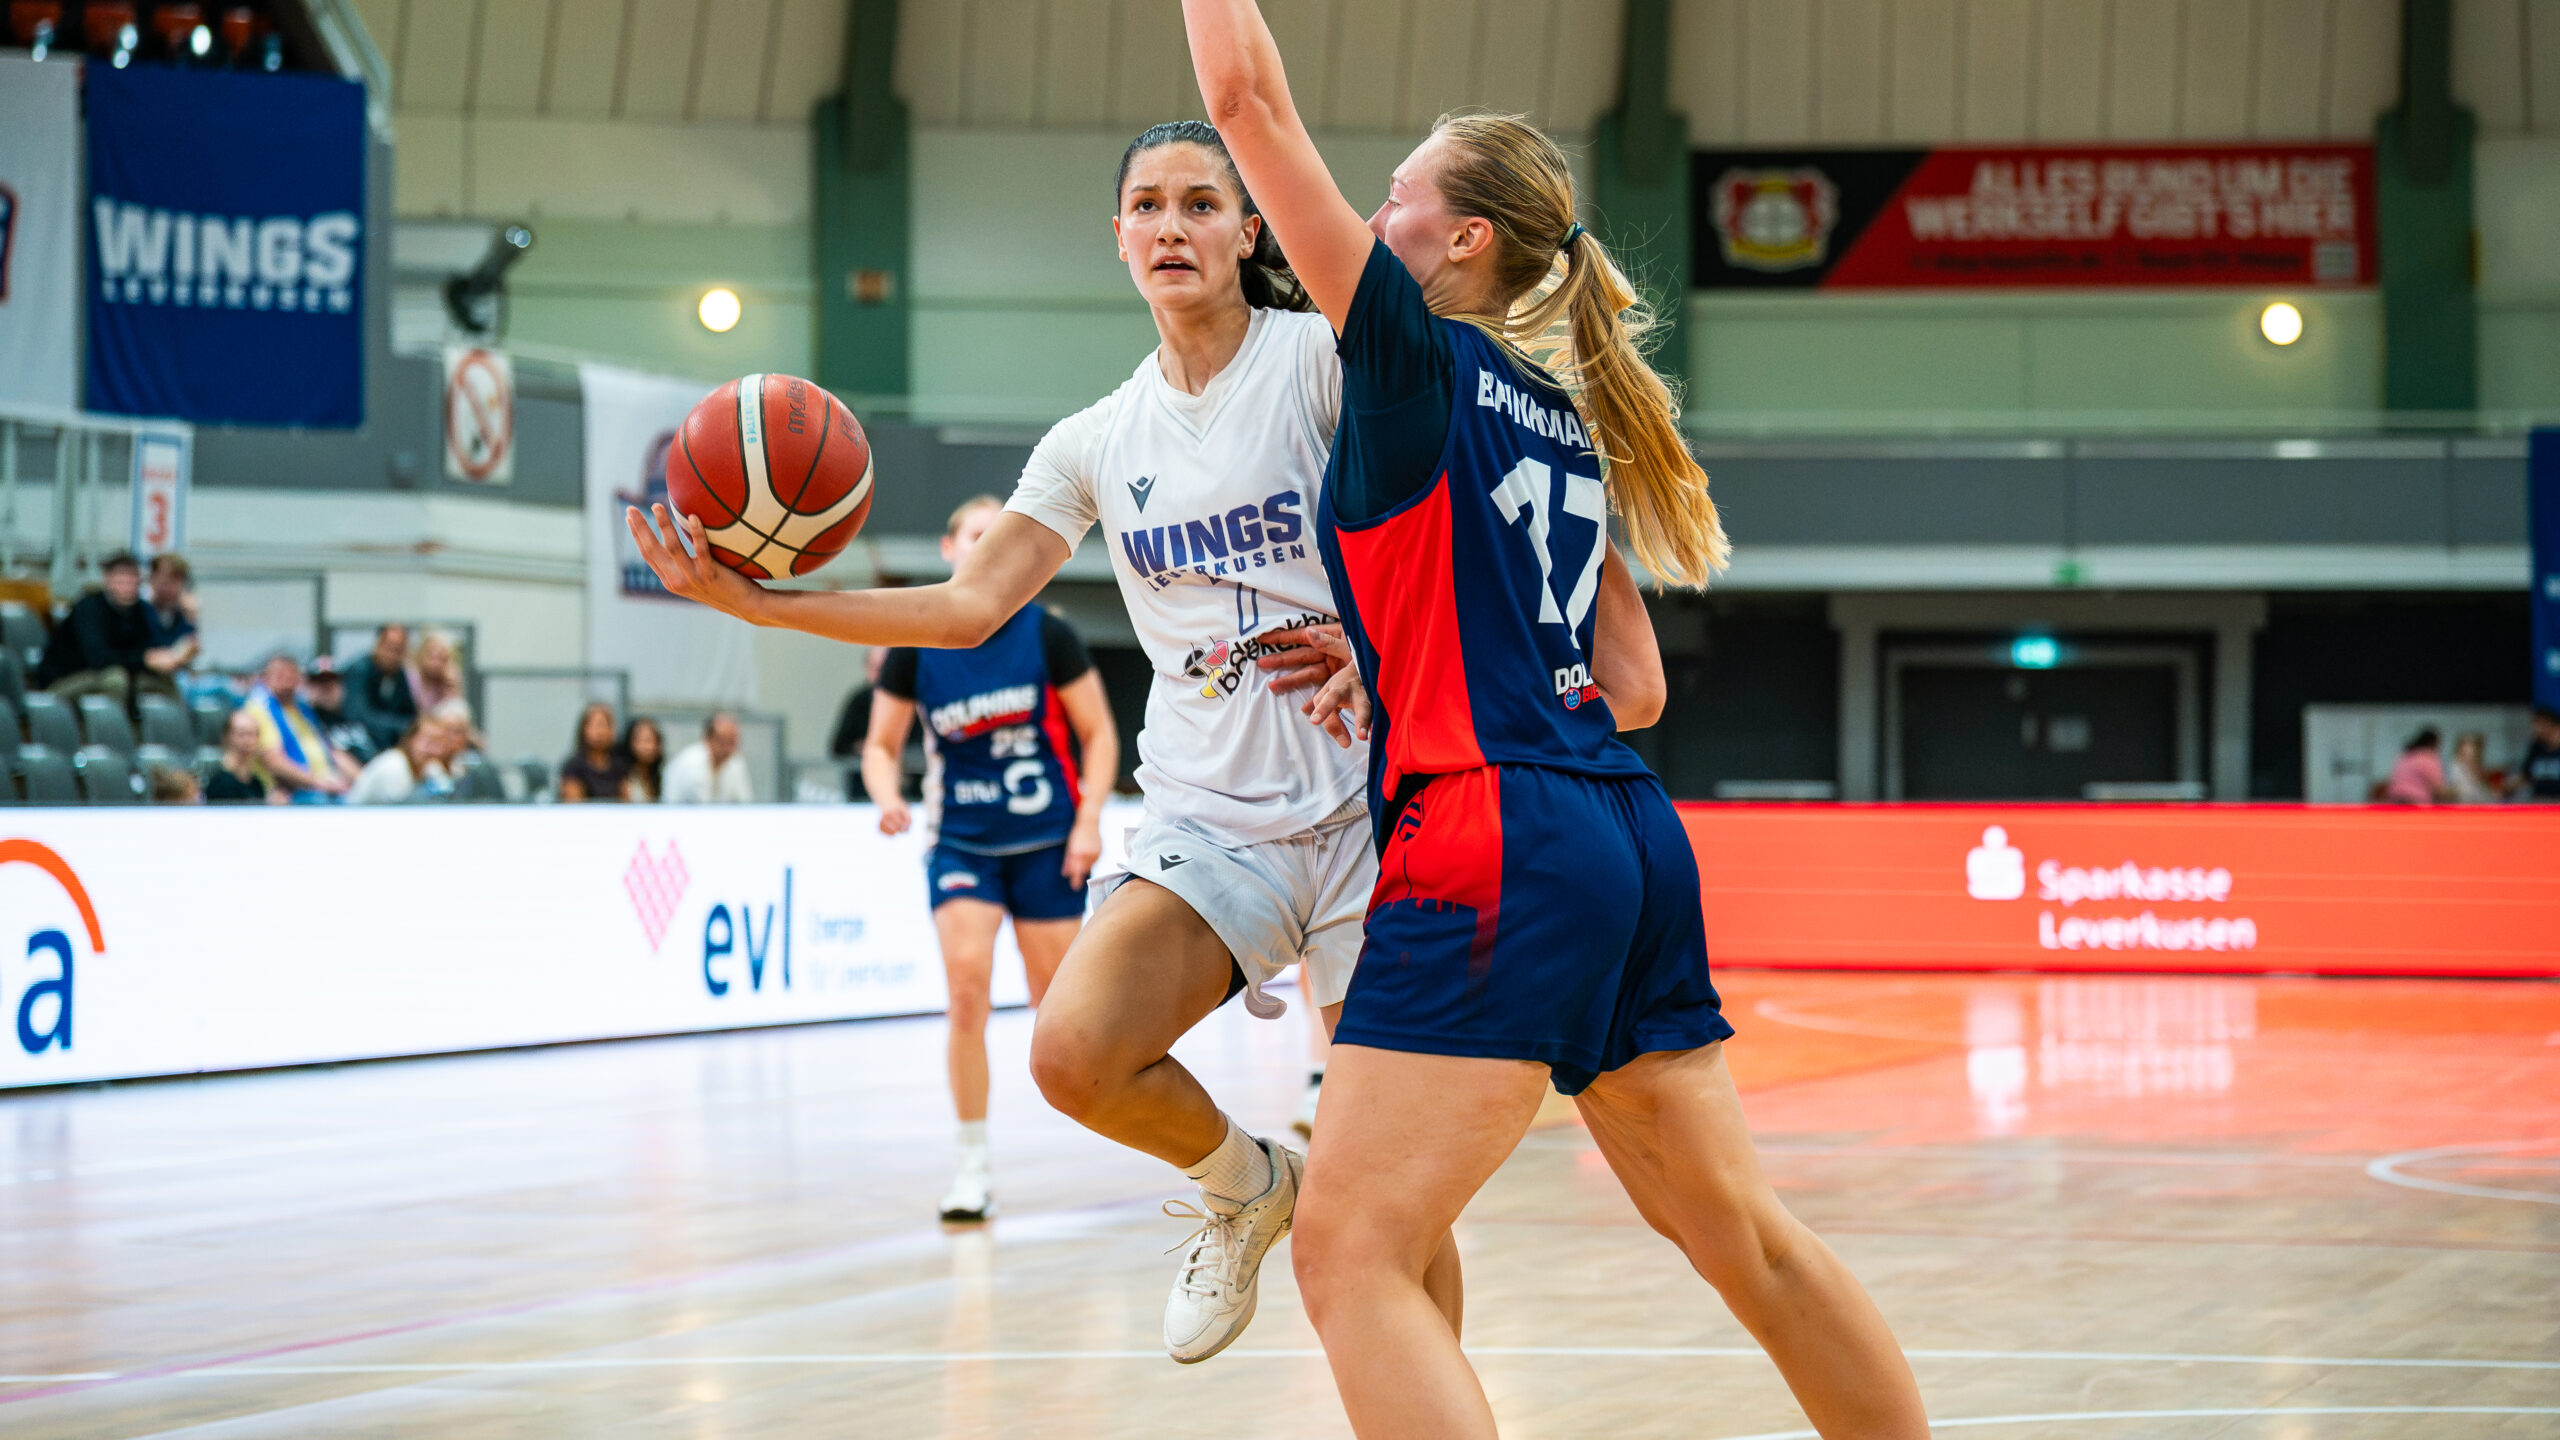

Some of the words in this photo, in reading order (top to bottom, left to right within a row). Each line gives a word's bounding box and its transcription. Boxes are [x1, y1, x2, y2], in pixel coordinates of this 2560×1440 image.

[1973, 158, 2097, 197] ALLES
[93, 195, 359, 286] WINGS
[1906, 198, 2121, 241] WERKSELF
[102, 278, 352, 315] LEVERKUSEN
[146, 491, 169, 545] 3
[1121, 490, 1302, 578] WINGS
[1555, 662, 1594, 695] DOL
[2037, 859, 2232, 907] Sparkasse
[705, 867, 792, 996] evl
[2038, 909, 2257, 951] Leverkusen
